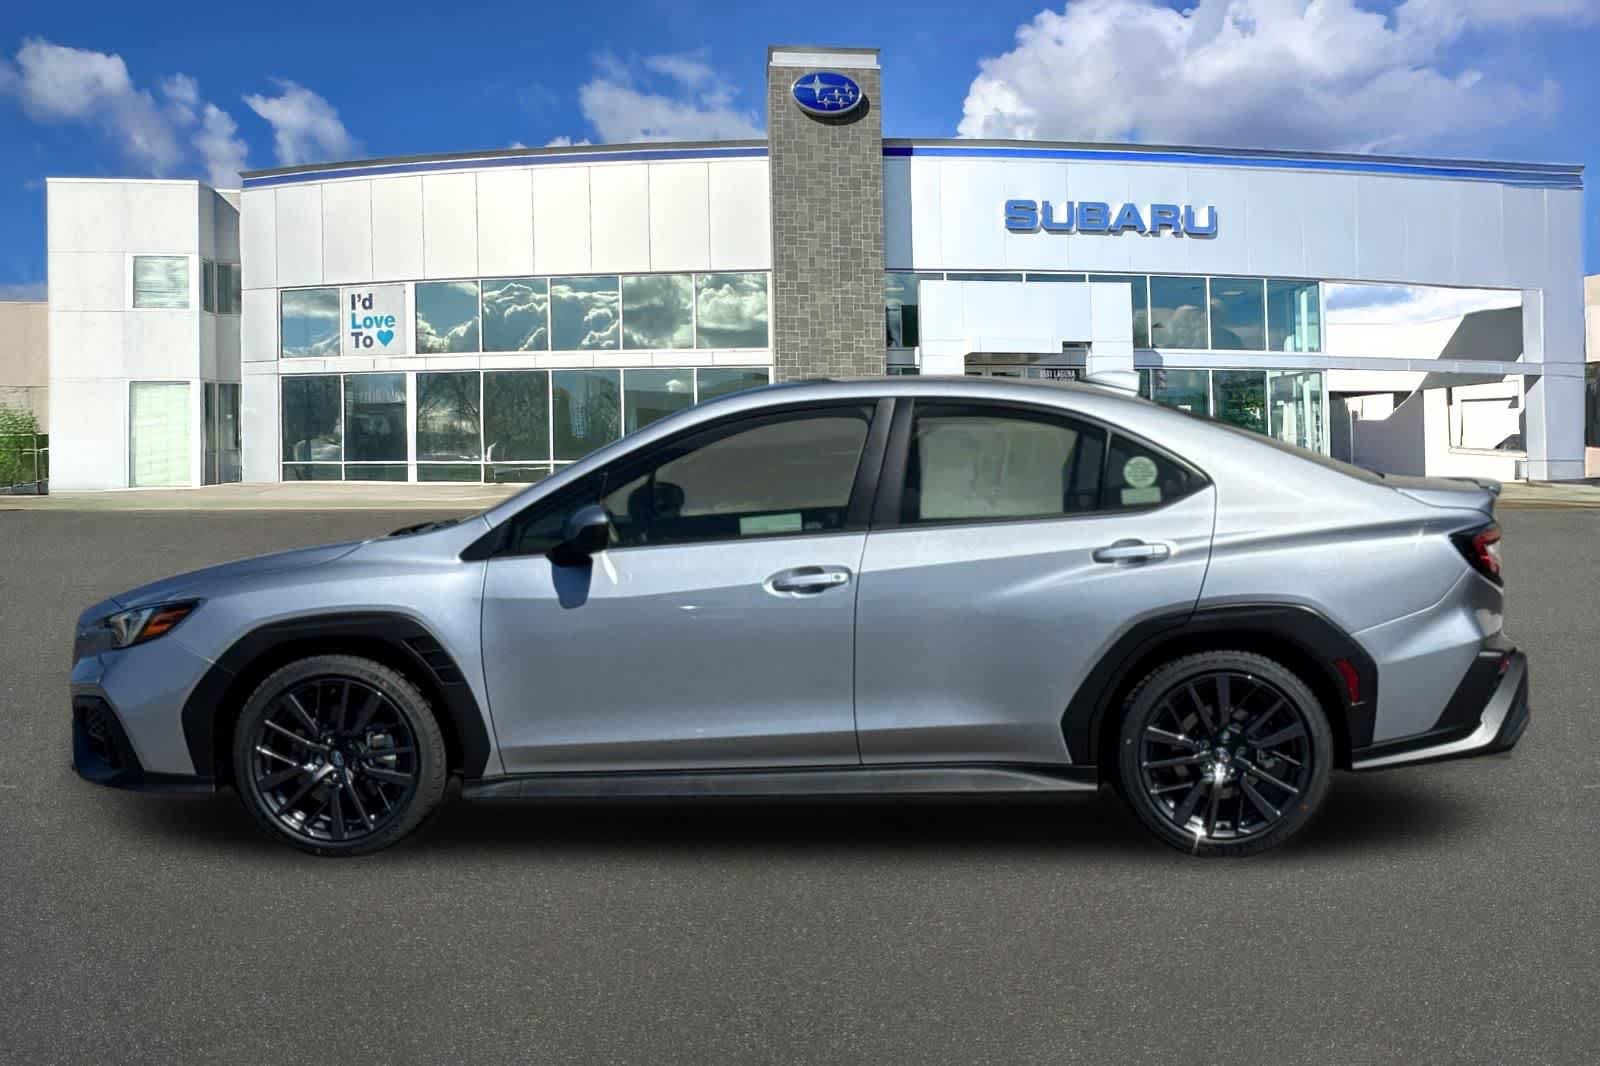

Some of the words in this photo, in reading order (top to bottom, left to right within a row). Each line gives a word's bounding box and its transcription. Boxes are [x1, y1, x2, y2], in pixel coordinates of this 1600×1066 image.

[1004, 199, 1218, 239] SUBARU
[351, 293, 373, 310] I'd
[351, 312, 396, 329] Love
[351, 331, 374, 348] To
